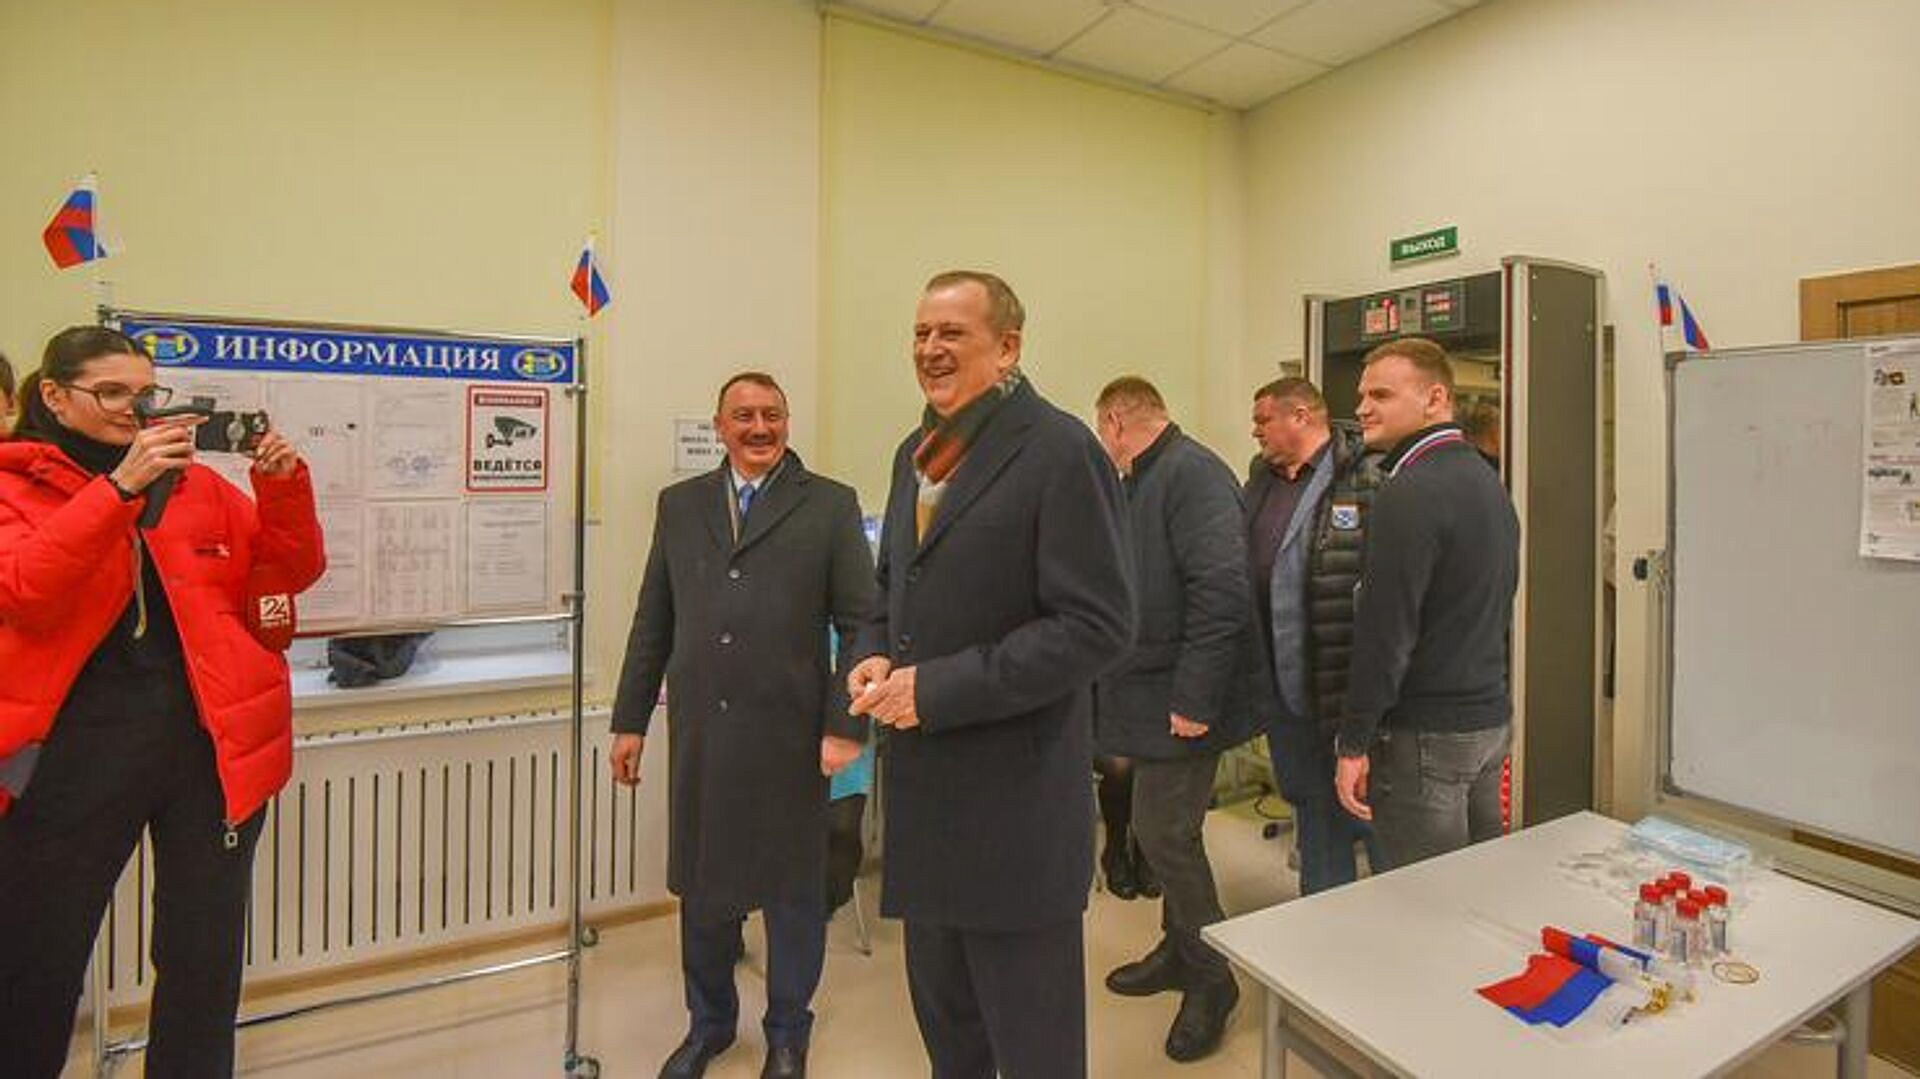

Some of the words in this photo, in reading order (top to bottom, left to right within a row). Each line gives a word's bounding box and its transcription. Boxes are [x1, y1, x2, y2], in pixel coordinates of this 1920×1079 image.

[1401, 236, 1446, 256] ВЫХОД
[213, 334, 501, 373] ИНФОРМАЦИЯ
[262, 598, 288, 619] 24
